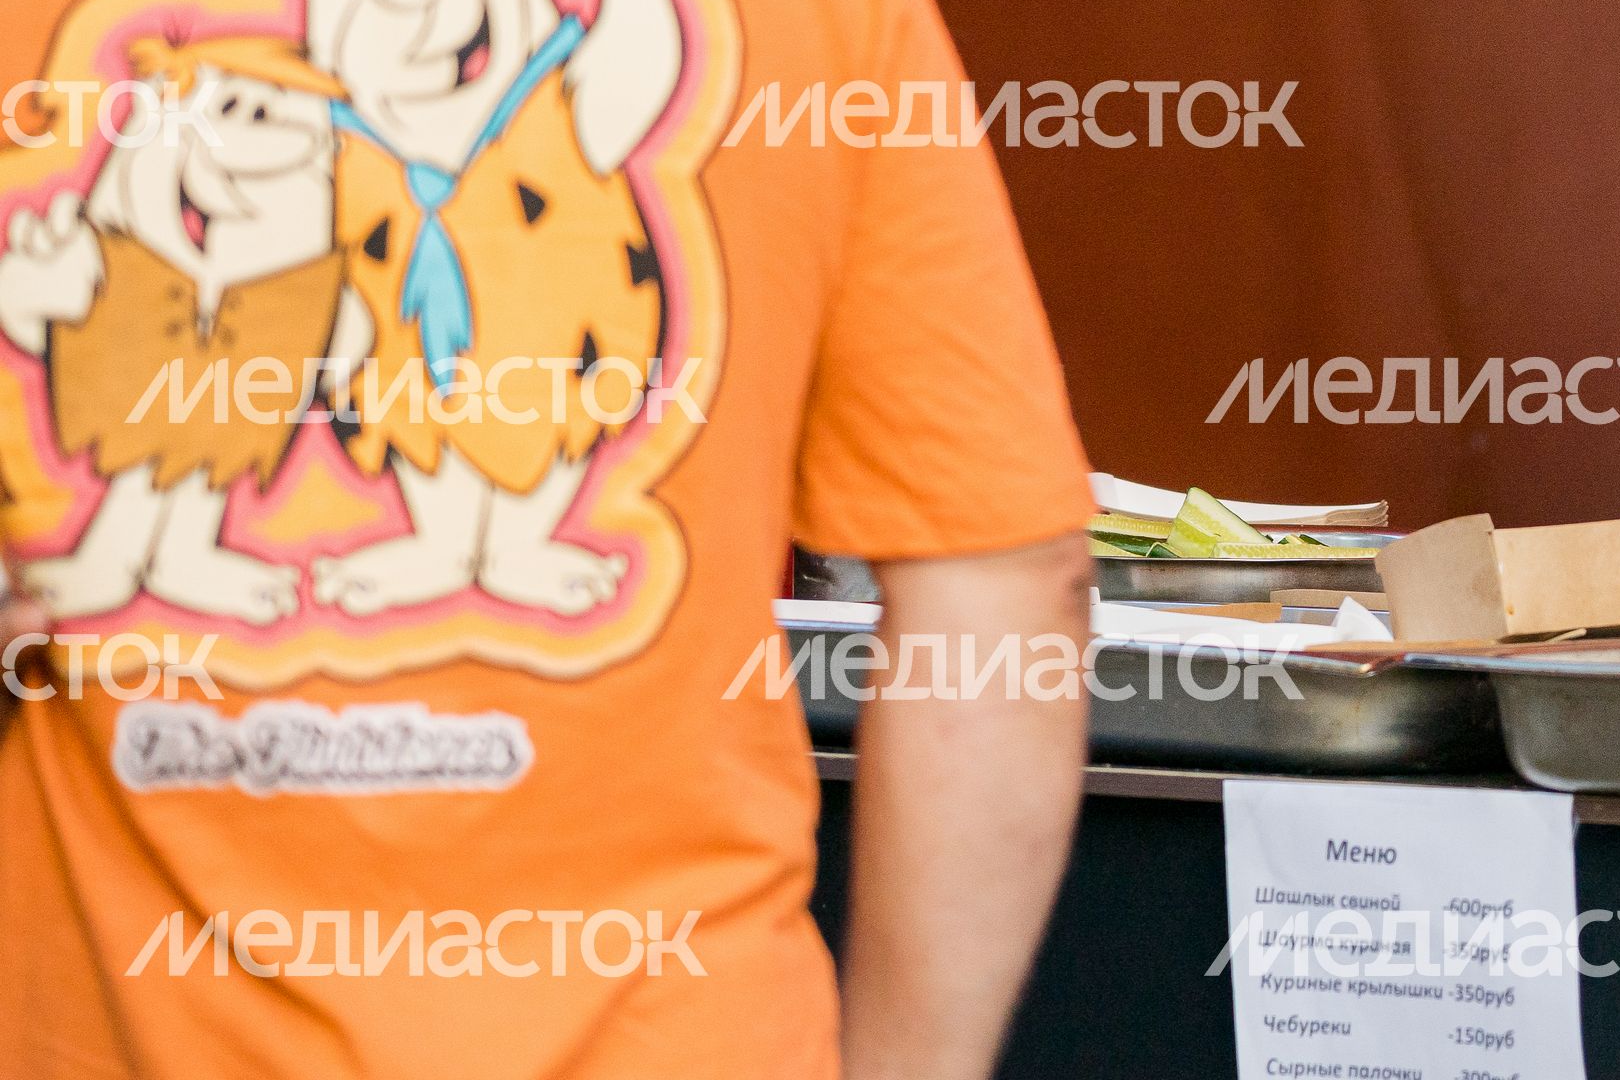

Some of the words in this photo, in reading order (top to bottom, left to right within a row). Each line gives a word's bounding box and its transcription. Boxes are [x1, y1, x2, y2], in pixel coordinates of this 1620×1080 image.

[1326, 838, 1397, 865] Меню
[1255, 887, 1334, 906] Шашлык
[1340, 894, 1401, 911] свиной
[1442, 897, 1514, 920] -600руб
[1260, 974, 1341, 994] Куриные
[1347, 979, 1443, 1000] крылышки
[1448, 983, 1515, 1008] -350руб
[1263, 1014, 1351, 1037] Чебуреки
[1447, 1026, 1515, 1052] -150руб
[1266, 1057, 1342, 1080] Сырные
[1348, 1063, 1423, 1080] палочки
